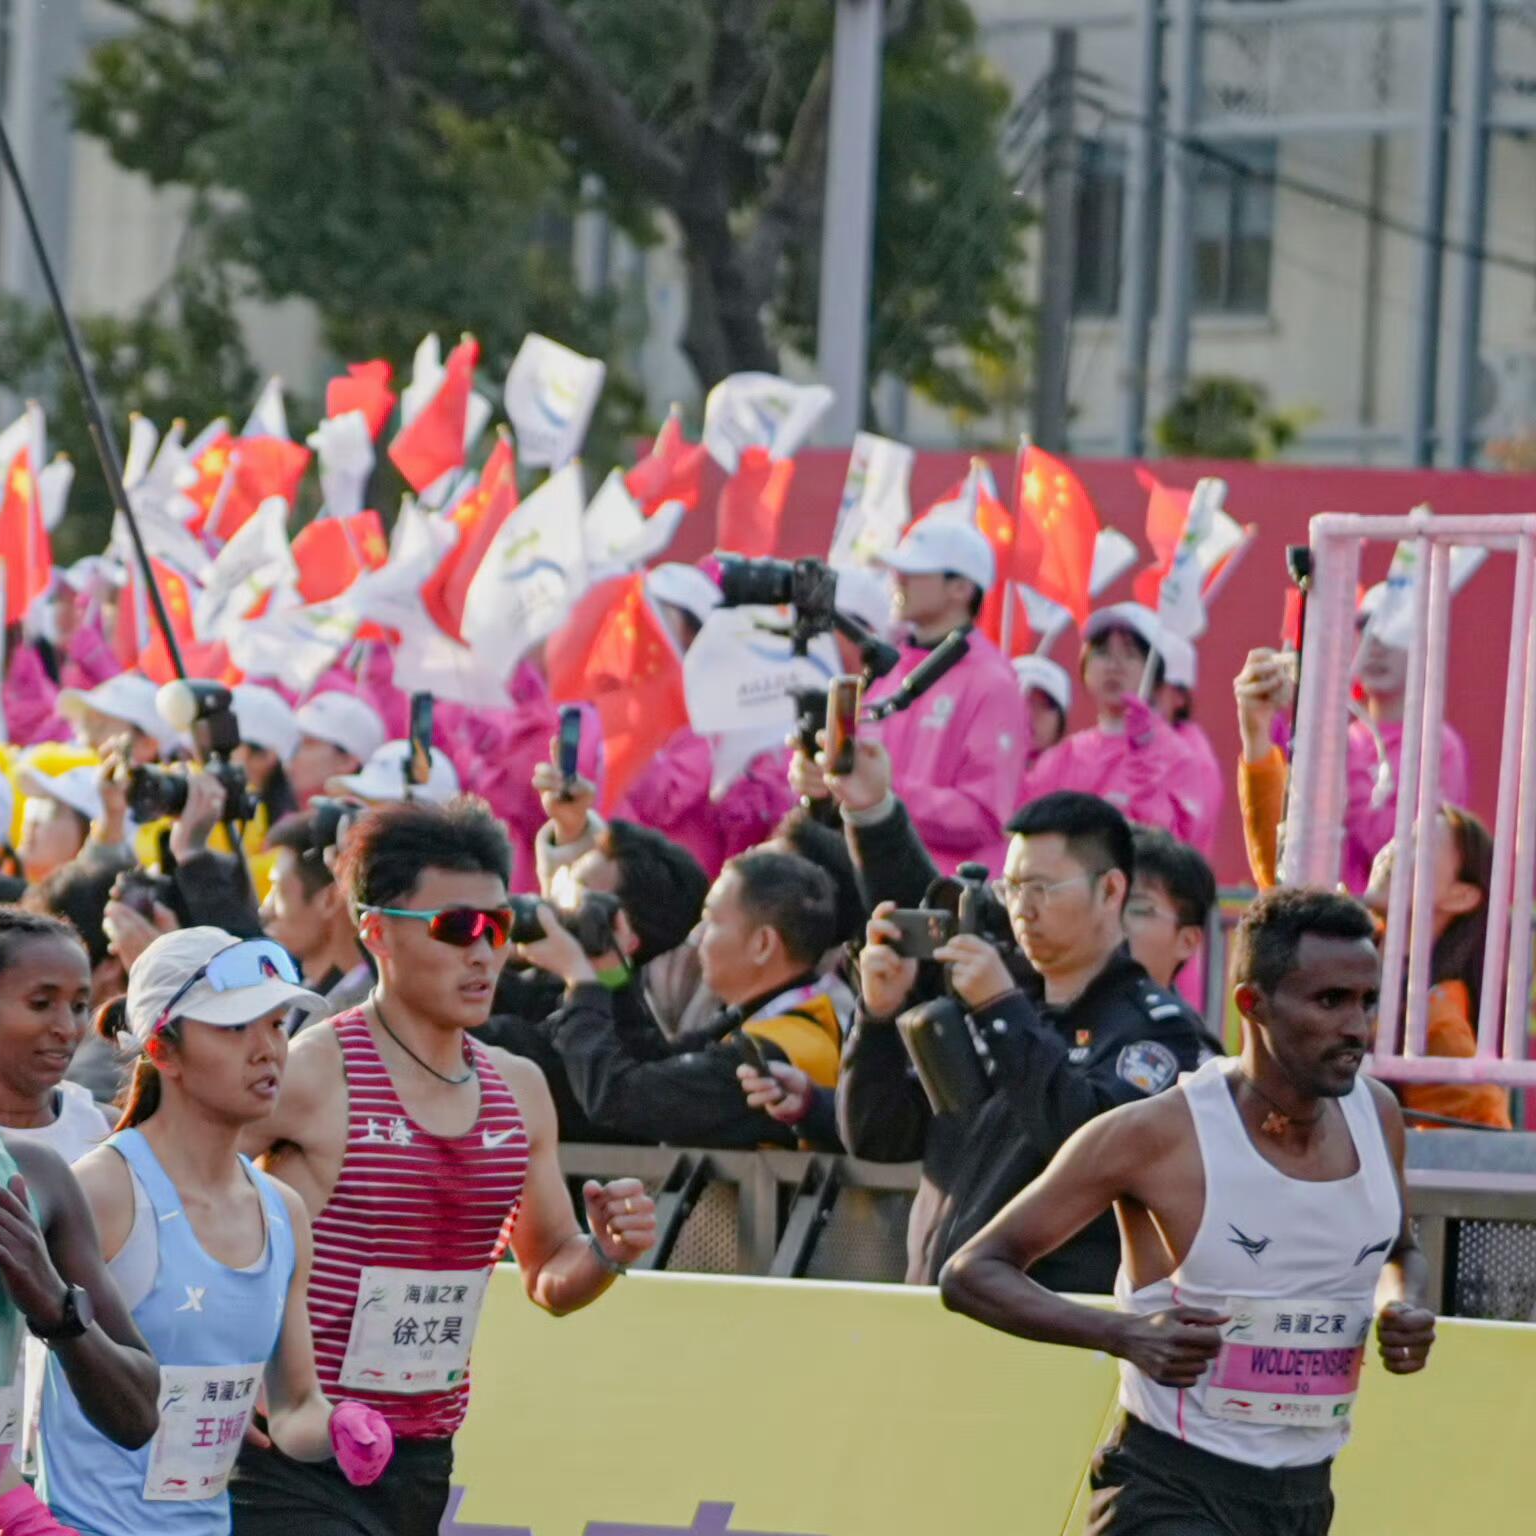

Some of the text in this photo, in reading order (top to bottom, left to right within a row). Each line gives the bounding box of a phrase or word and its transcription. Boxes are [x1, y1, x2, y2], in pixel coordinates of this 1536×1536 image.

[360, 1117, 412, 1146] 上海
[404, 1283, 469, 1304] 海澜之家
[393, 1316, 463, 1346] 徐文昊
[1274, 1313, 1346, 1334] 海澜之家
